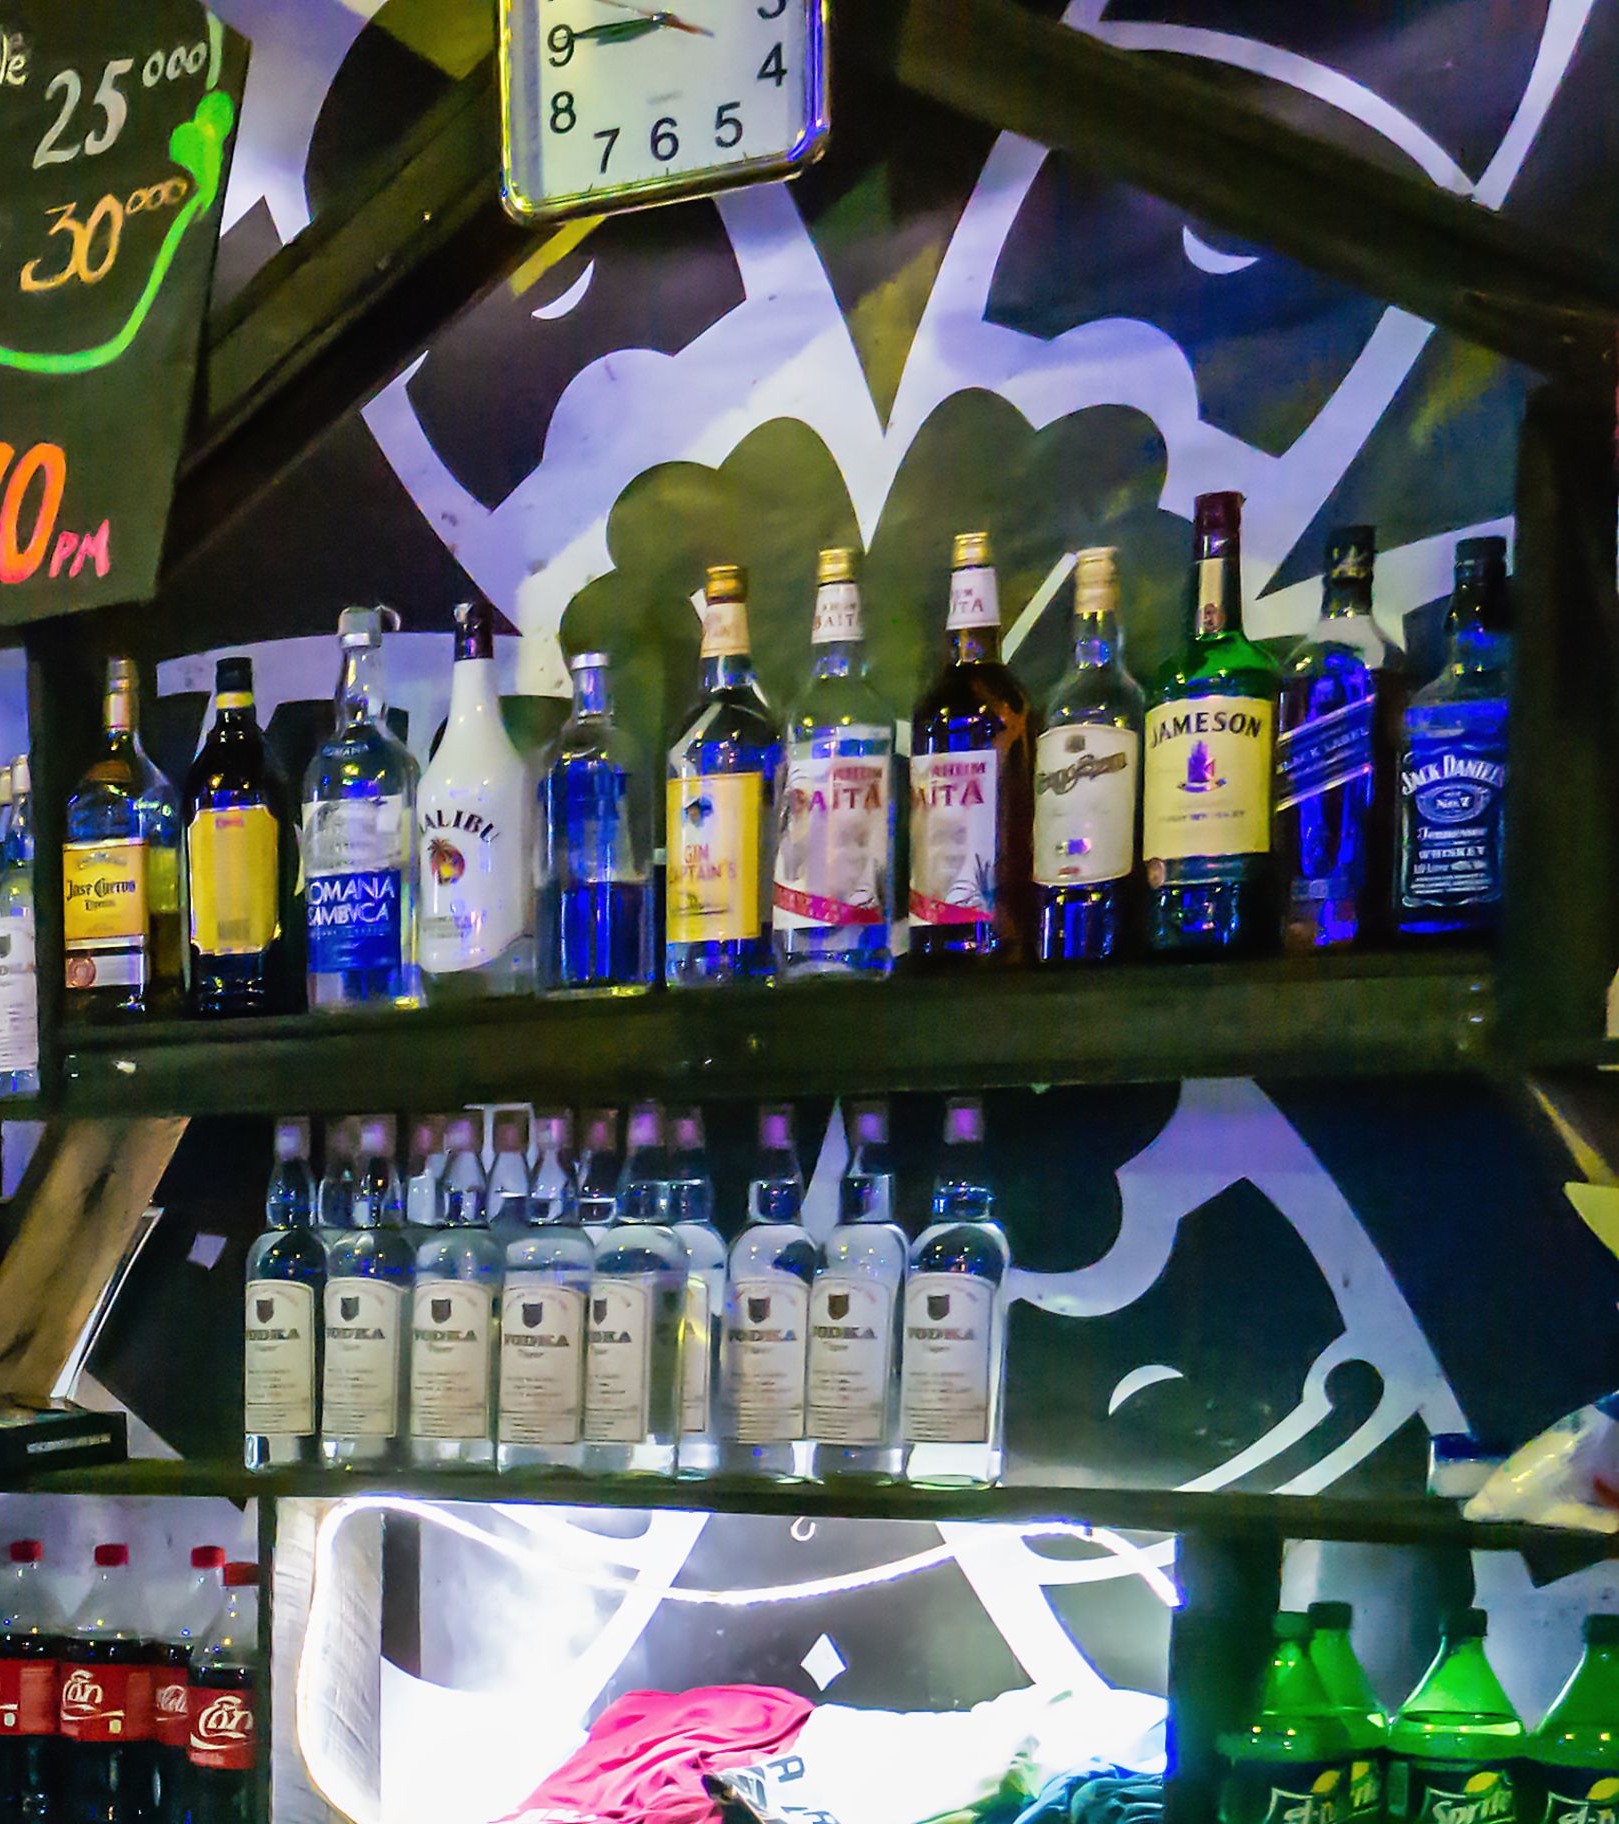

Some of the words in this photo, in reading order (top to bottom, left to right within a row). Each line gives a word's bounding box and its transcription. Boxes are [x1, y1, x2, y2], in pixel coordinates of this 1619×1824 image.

[547, 23, 575, 68] 9
[756, 41, 788, 87] 4
[549, 91, 577, 134] 8
[714, 101, 744, 148] 5
[593, 127, 621, 174] 7
[650, 116, 680, 161] 6
[47, 518, 111, 579] PM
[1149, 711, 1262, 749] JAMESON
[1401, 762, 1441, 796] JACK
[308, 875, 396, 906] OMANA
